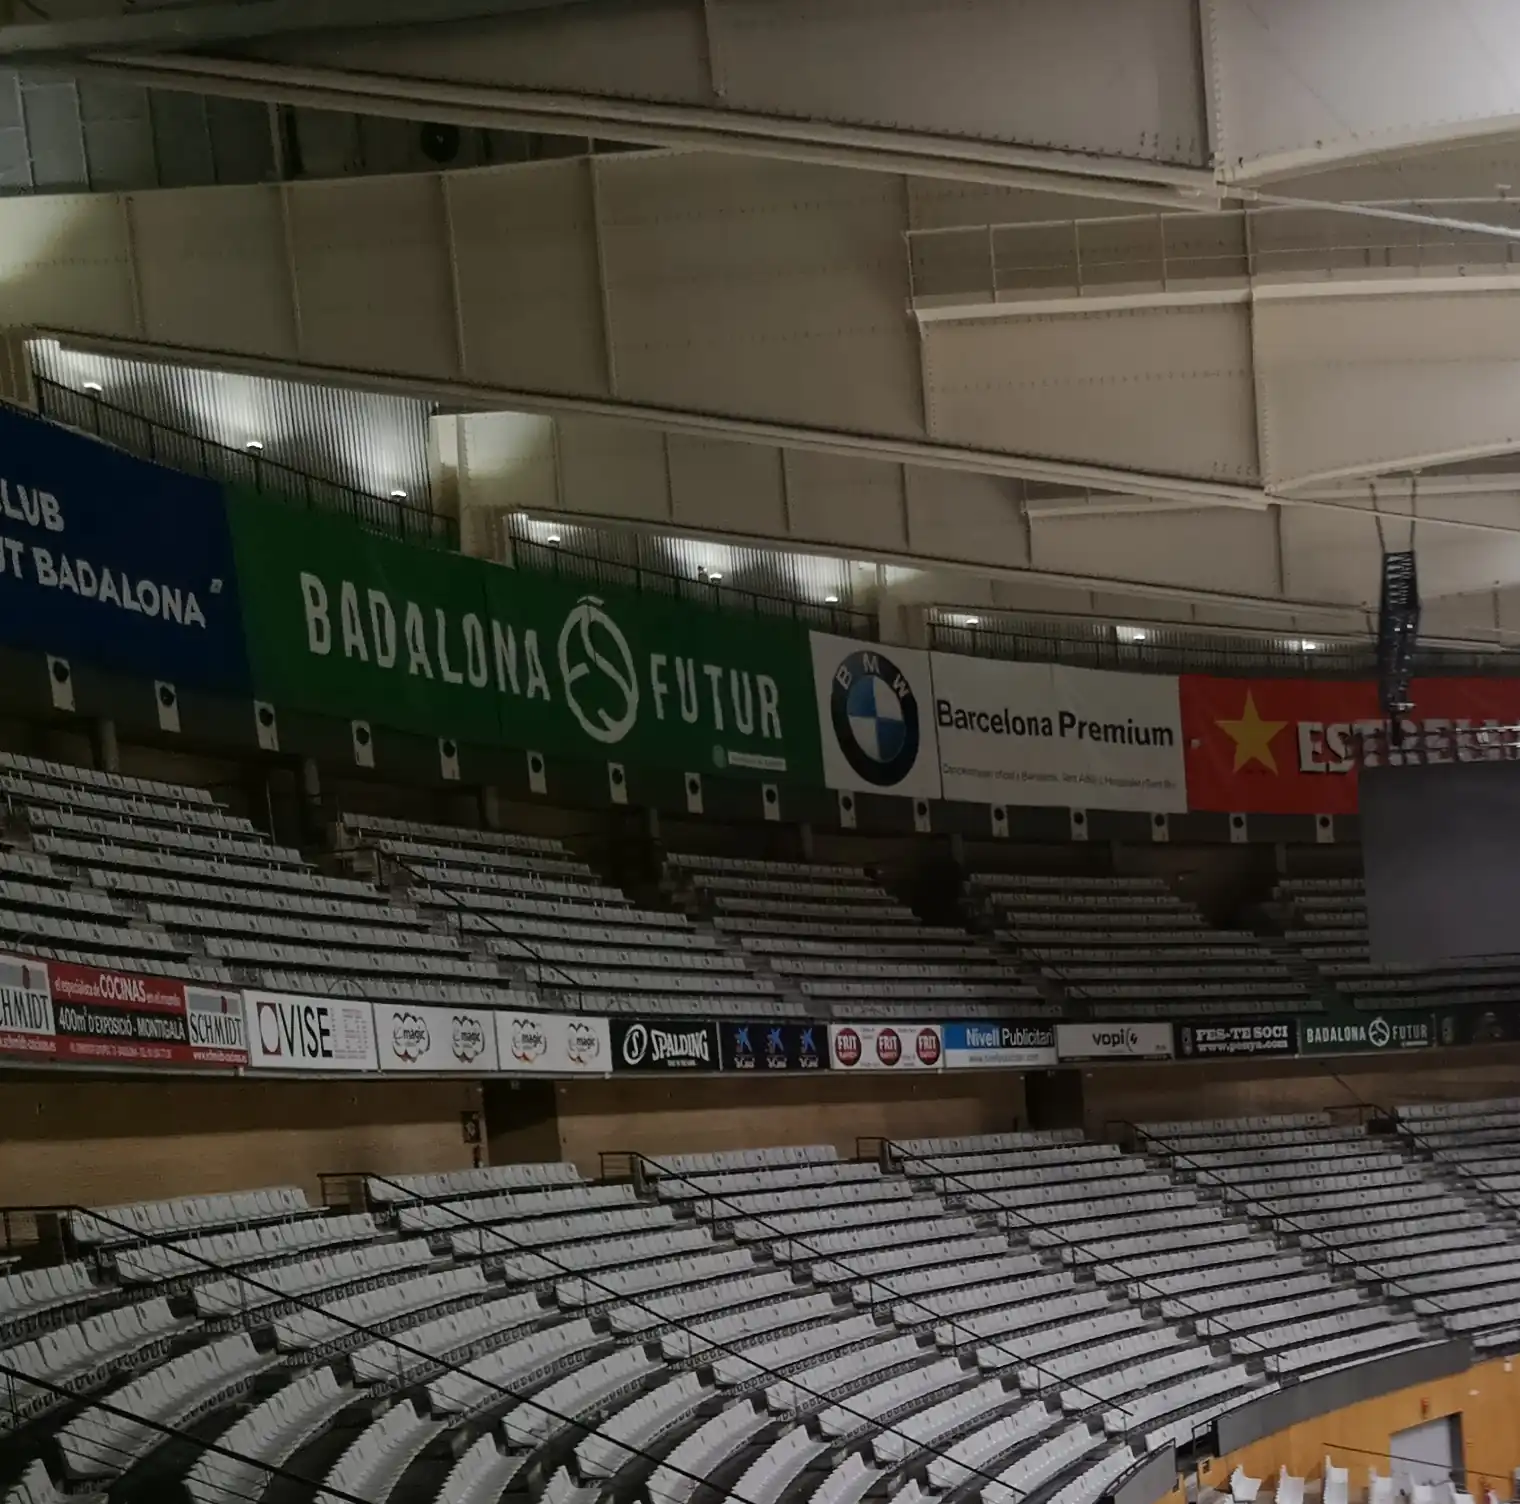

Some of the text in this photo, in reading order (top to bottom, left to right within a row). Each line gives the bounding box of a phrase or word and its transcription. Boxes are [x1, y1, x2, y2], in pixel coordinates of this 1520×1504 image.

[0, 477, 65, 533] LUB
[299, 570, 783, 740] BADALONA FUTUR
[936, 699, 1174, 747] Barcelona Premium
[100, 973, 146, 1004] COCINAS
[0, 989, 50, 1032] HMIDT
[190, 1012, 244, 1047] SCHMIDT
[650, 1027, 710, 1063] SPALDING
[837, 1035, 858, 1051] FRIT
[879, 1036, 898, 1051] FRIT
[918, 1036, 937, 1051] FRIT
[966, 1027, 1054, 1048] Nivell Publicitari
[1253, 1024, 1289, 1039] SOCI
[1306, 1022, 1429, 1044] BADALONA FUTUR
